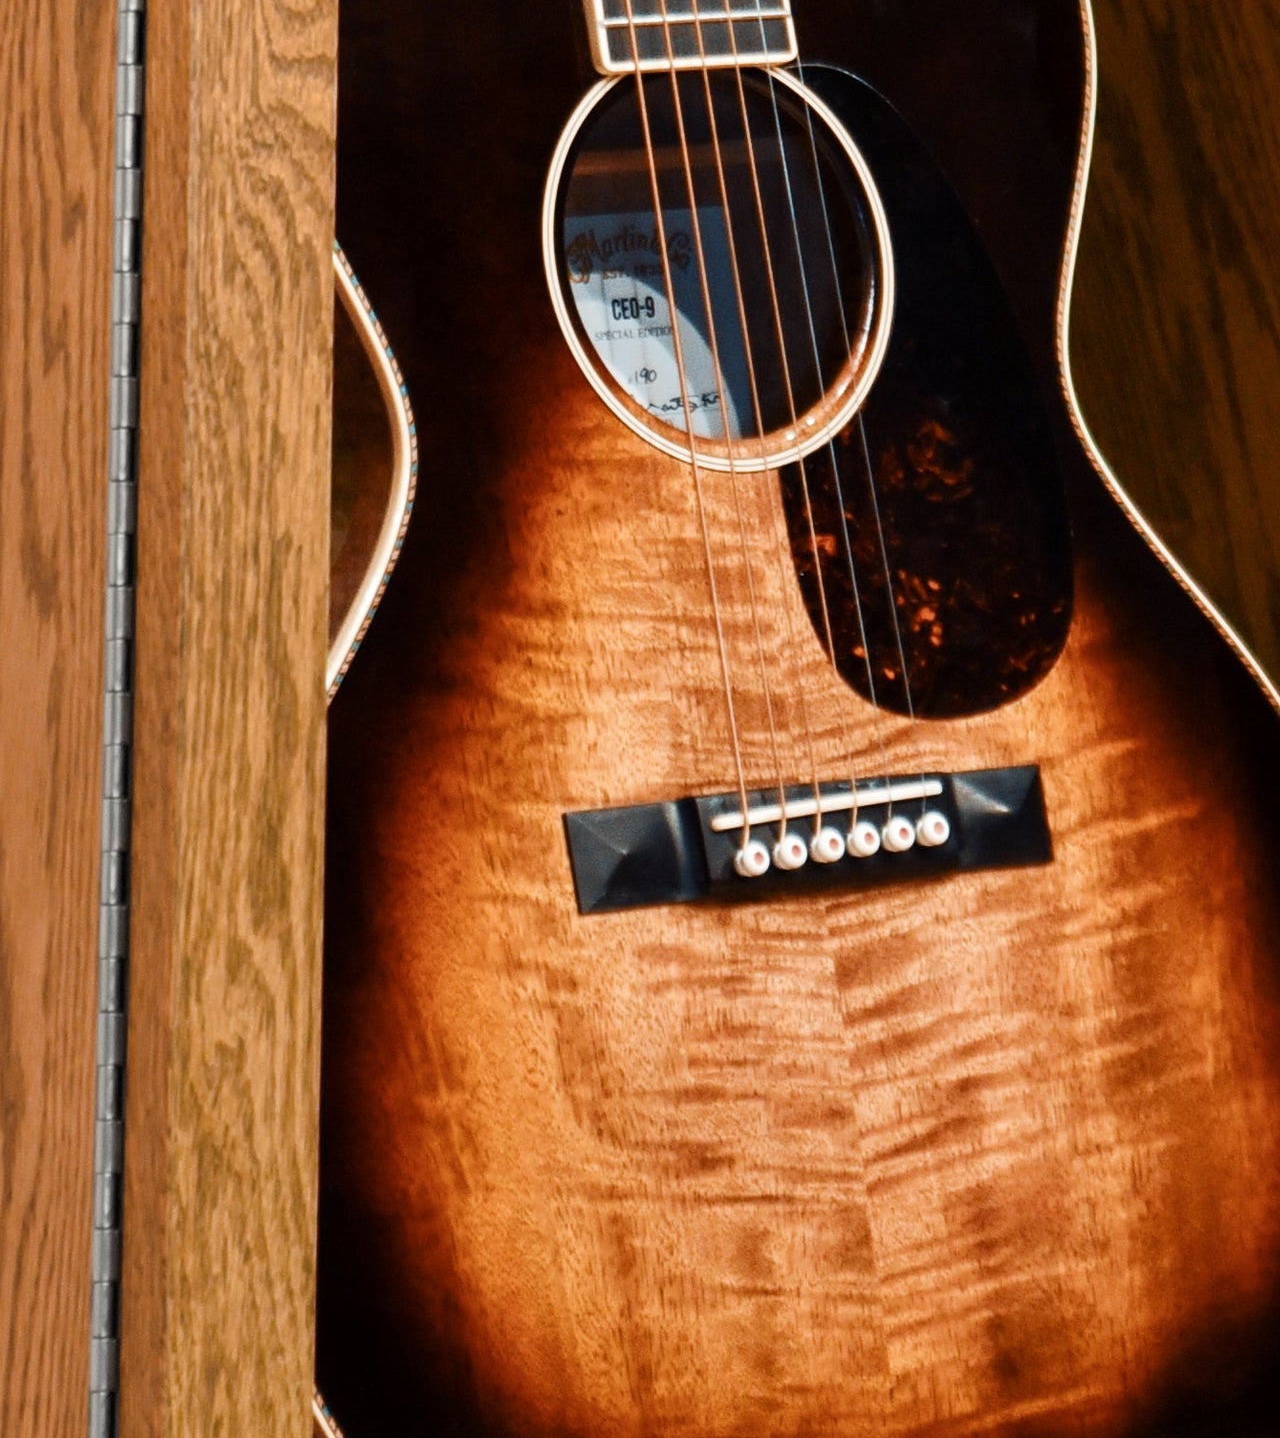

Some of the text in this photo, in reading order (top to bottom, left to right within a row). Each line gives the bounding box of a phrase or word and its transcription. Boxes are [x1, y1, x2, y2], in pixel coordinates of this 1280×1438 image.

[611, 296, 655, 321] CEO-9
[595, 325, 675, 341] SPECIAL EDITIO
